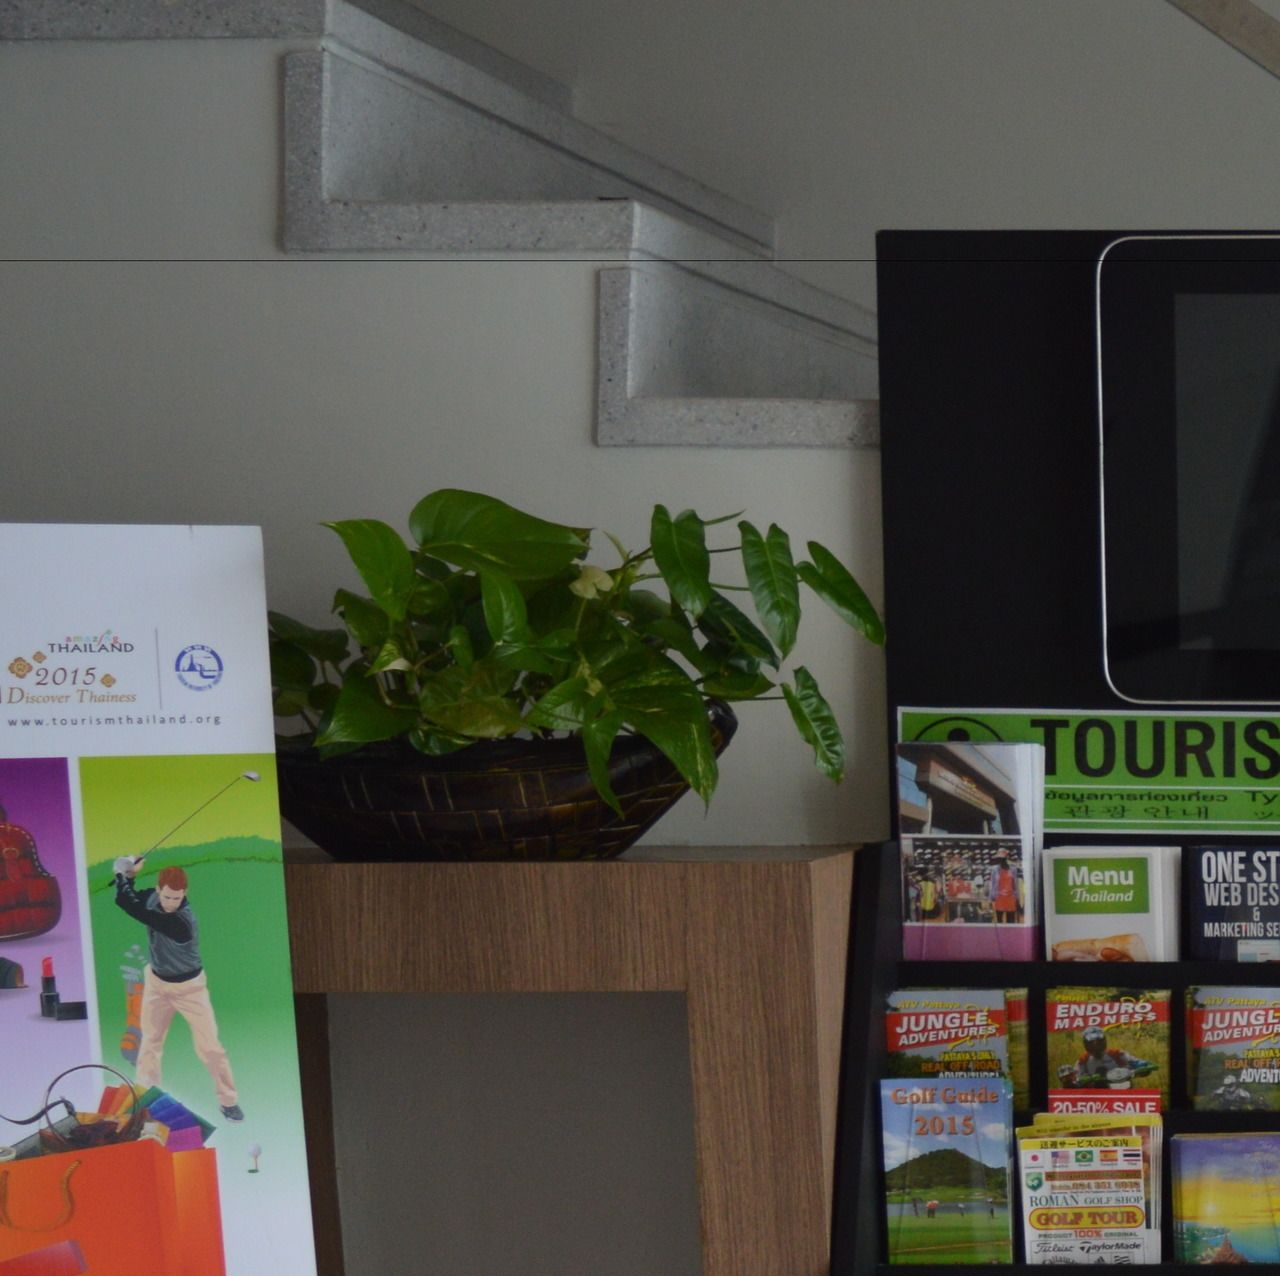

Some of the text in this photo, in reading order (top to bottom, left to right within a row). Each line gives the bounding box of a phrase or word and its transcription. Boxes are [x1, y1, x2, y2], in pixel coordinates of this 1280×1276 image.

[48, 643, 134, 653] THAILAND
[35, 667, 96, 686] 2015
[7, 687, 71, 704] Discover
[8, 714, 221, 728] www.tourismthailand.org
[1202, 851, 1247, 883] ONE
[1067, 866, 1134, 887] Menu
[1070, 888, 1134, 904] Thailand
[1204, 883, 1242, 906] WEB
[1203, 921, 1263, 938] MARKETING
[1056, 1002, 1152, 1018] ENDURO
[896, 1010, 988, 1033] JUNGLE
[1054, 1011, 1158, 1030] MADNESS
[898, 1025, 998, 1046] ADVENTURES
[891, 1087, 999, 1105] Golf Guide
[1053, 1101, 1157, 1114] 20-50% SALE
[914, 1115, 976, 1136] 2015
[1029, 1194, 1080, 1207] ROMAN
[1036, 1211, 1137, 1226] GOLF TOUR
